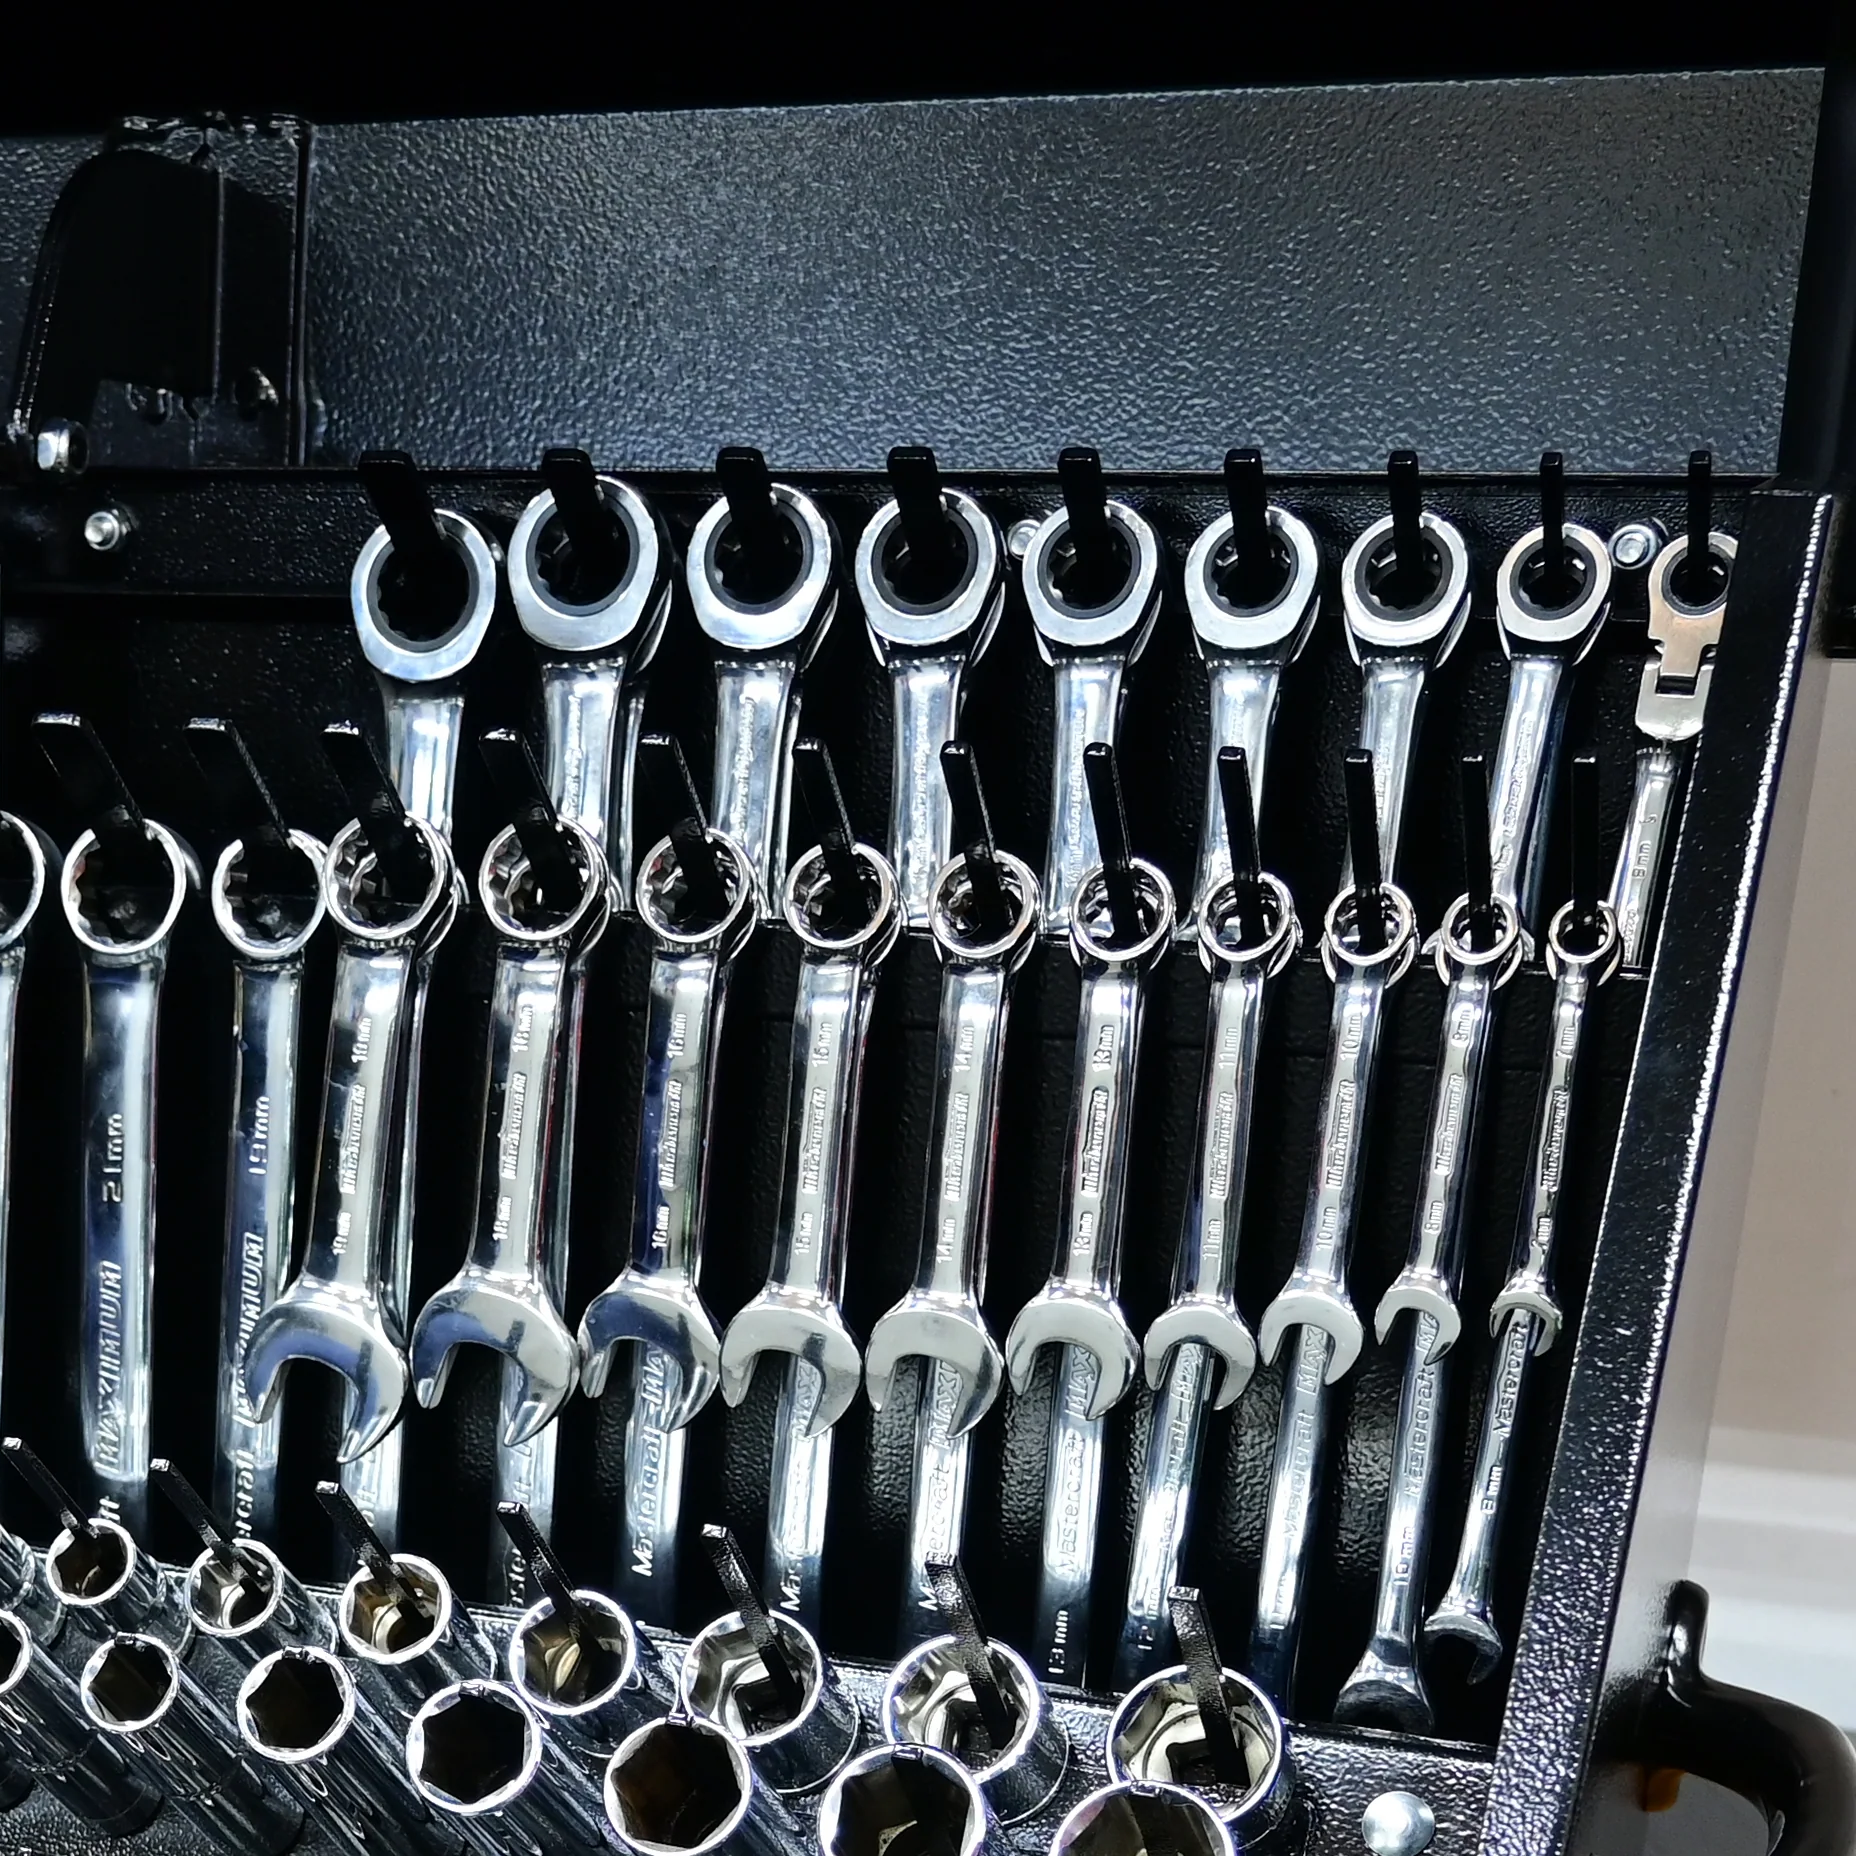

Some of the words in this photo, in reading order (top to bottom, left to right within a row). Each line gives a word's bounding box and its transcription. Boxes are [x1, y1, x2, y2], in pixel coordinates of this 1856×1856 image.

[101, 1112, 125, 1204] 21mm
[1402, 1367, 1435, 1498] Mastercraft
[1491, 1320, 1528, 1438] Mastercraft
[1055, 1430, 1086, 1575] Mastercraft
[1283, 1410, 1315, 1538] Mastercraft
